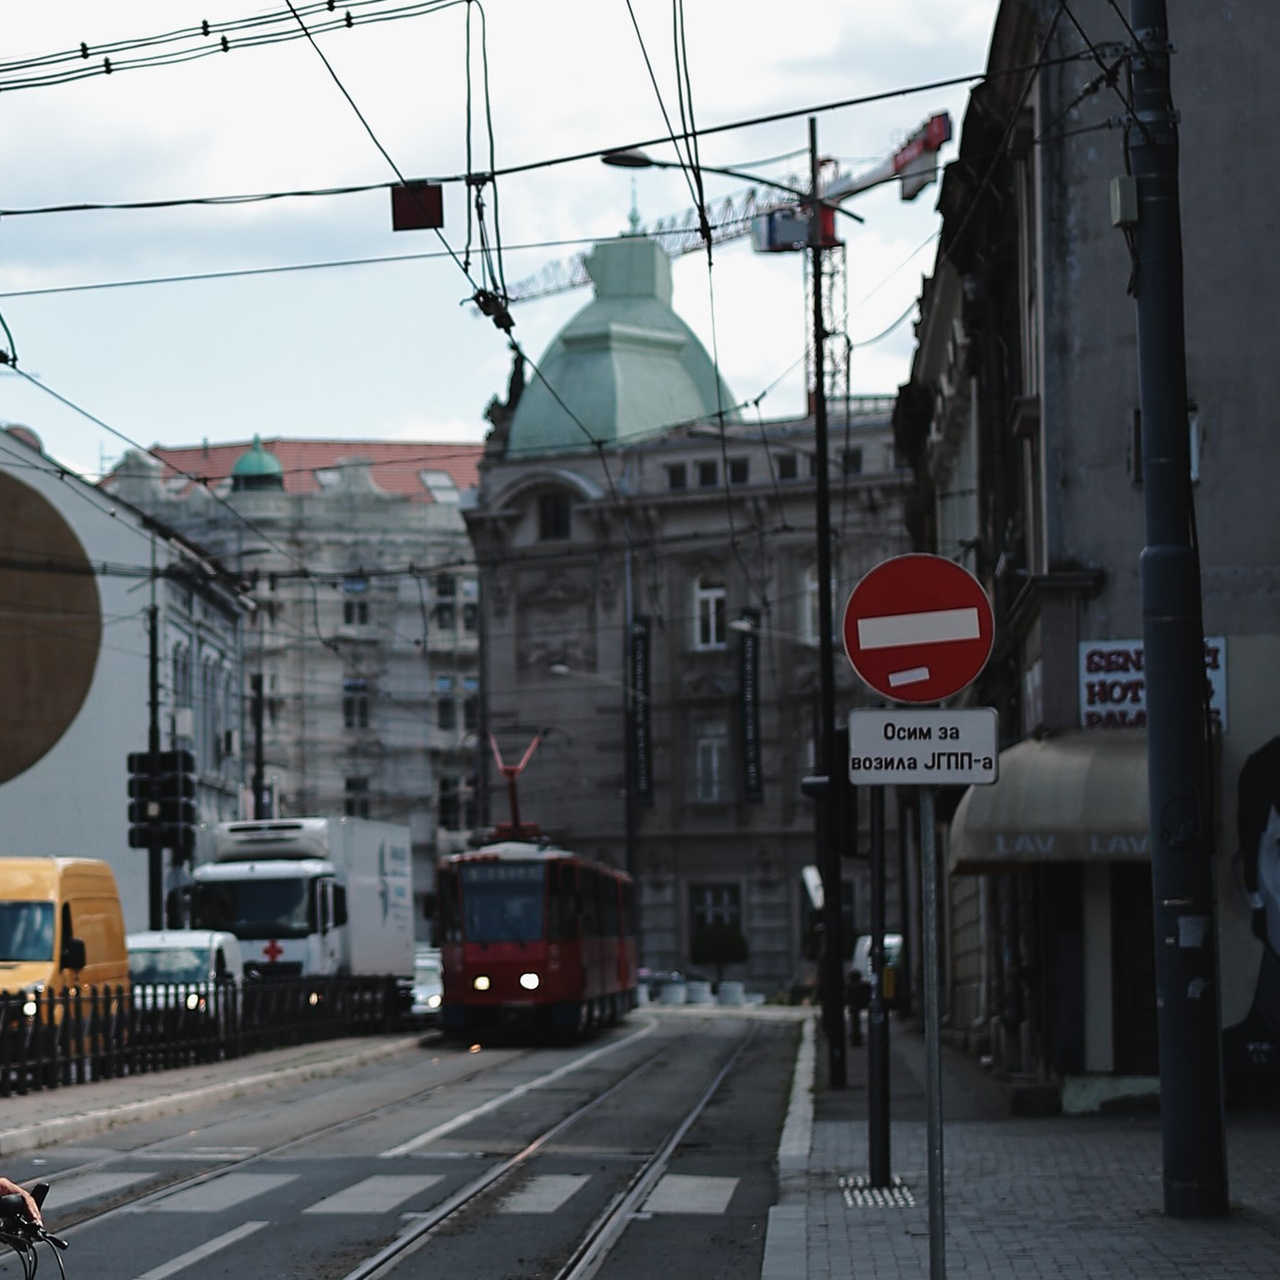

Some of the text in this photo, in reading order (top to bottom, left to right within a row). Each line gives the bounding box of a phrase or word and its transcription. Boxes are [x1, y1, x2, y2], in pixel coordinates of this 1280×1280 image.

[1086, 680, 1144, 705] HOT
[883, 722, 960, 741] Осим за
[851, 756, 918, 771] возила
[995, 833, 1150, 855] LAV LAV
